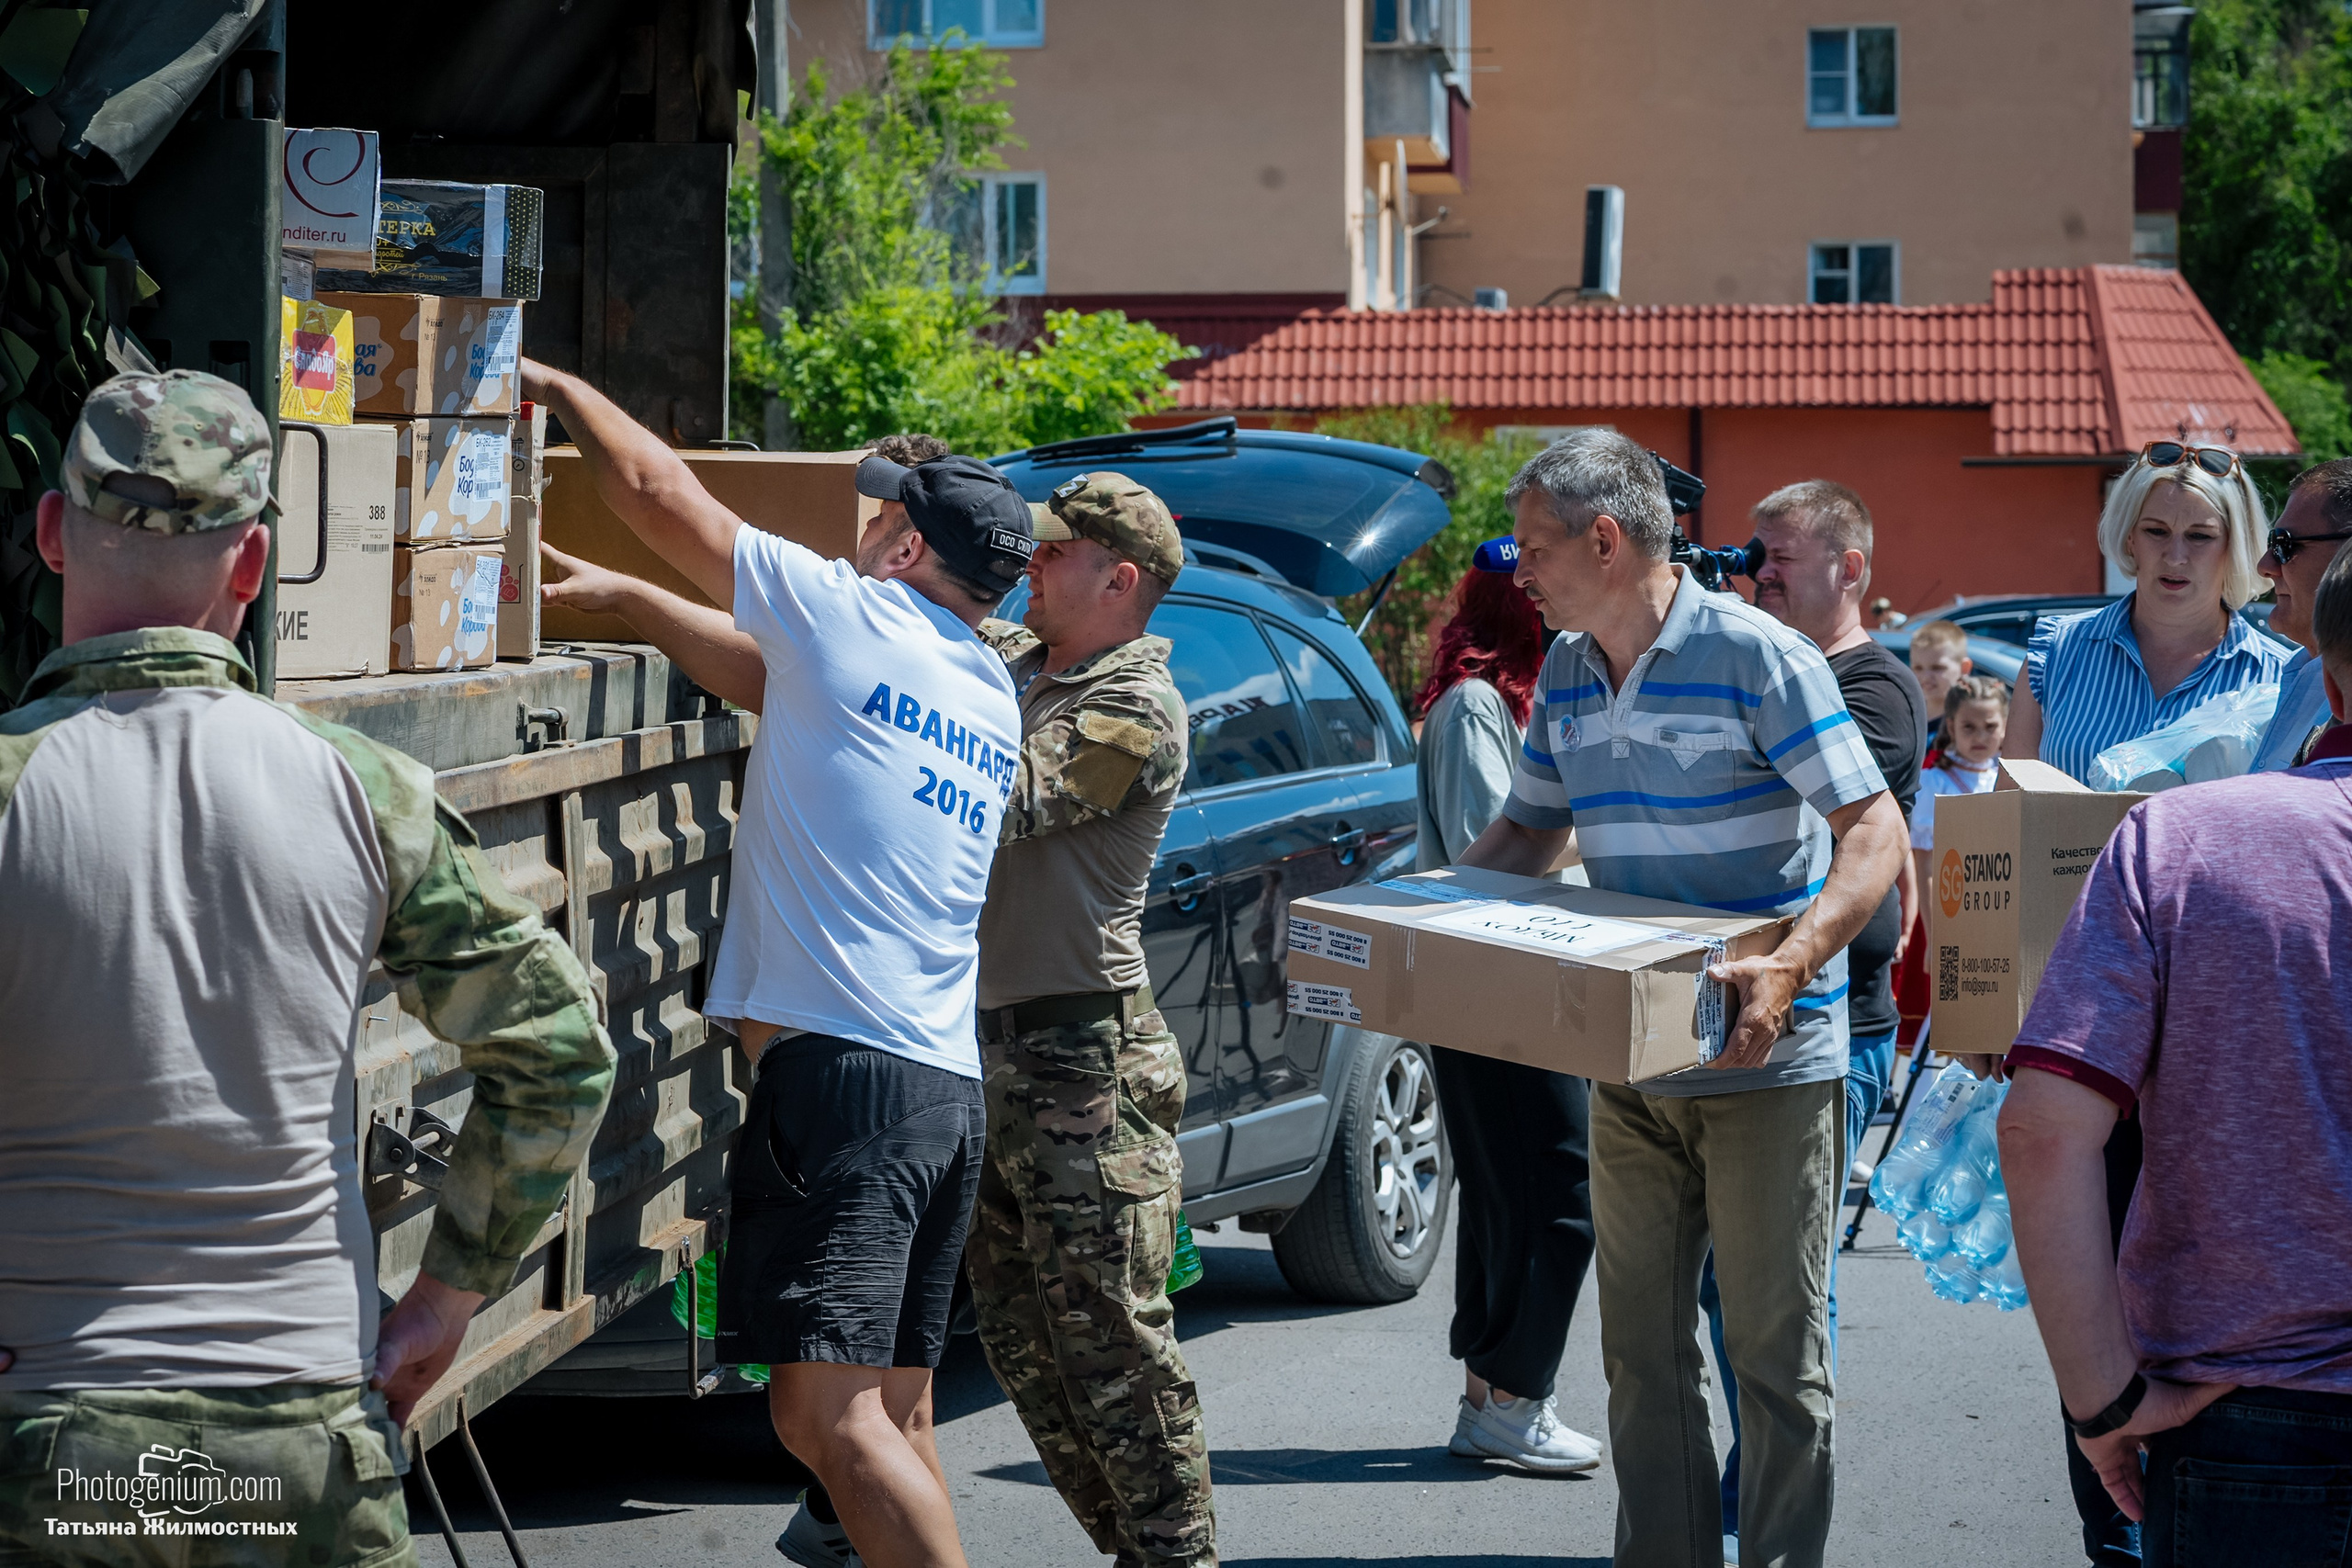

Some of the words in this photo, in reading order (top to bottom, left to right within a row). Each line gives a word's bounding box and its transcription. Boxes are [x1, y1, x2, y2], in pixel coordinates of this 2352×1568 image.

[419, 273, 447, 282] Рязань
[368, 505, 386, 521] 388
[862, 682, 1015, 802] АВАНГАРД
[913, 766, 987, 834] 2016
[1964, 852, 2011, 883] STANCO
[1941, 865, 1962, 902] SG
[1964, 891, 2010, 911] GROUP
[1962, 958, 2010, 973] 8-800-100-57-25
